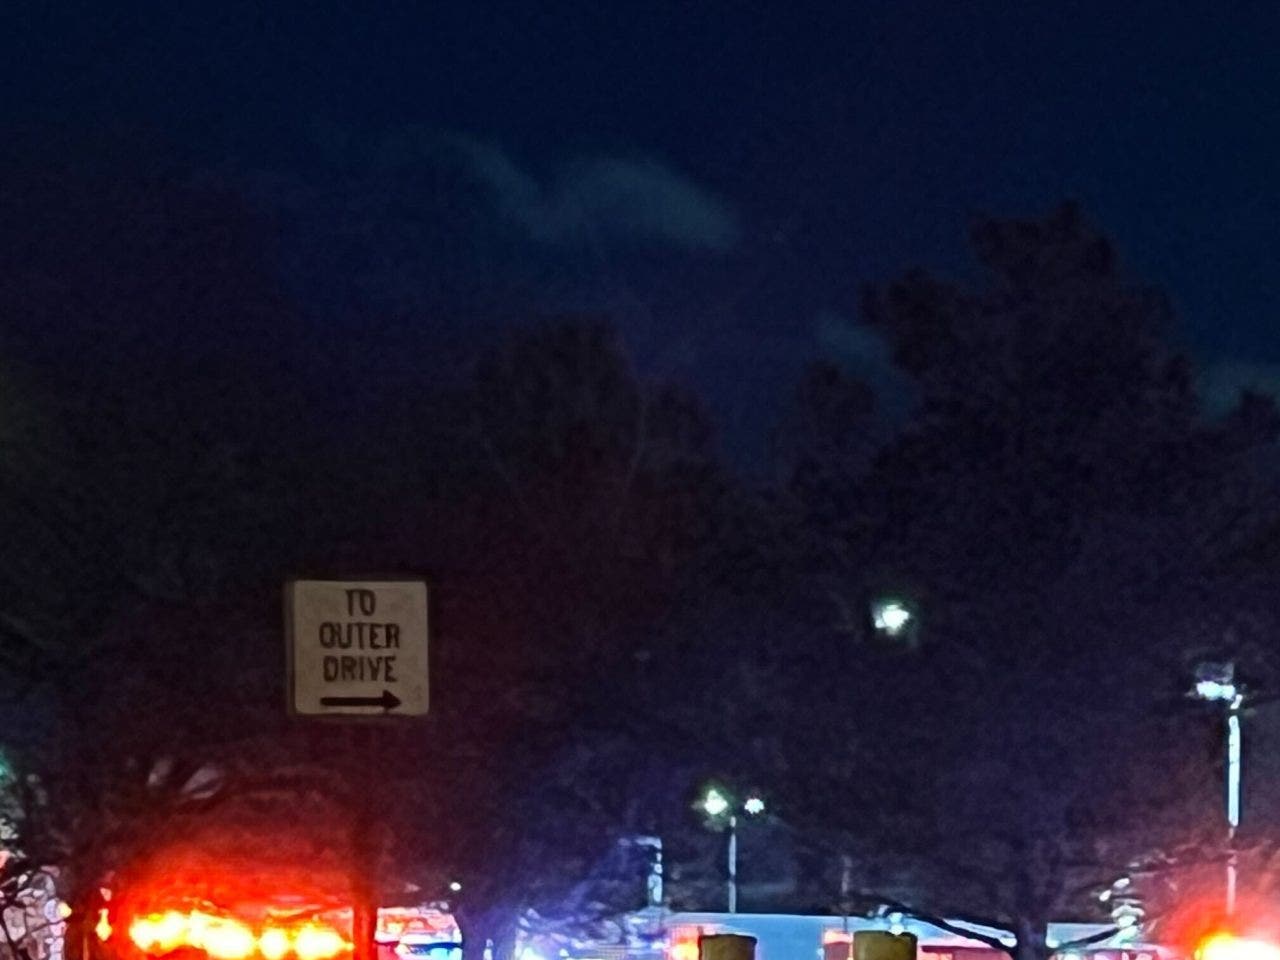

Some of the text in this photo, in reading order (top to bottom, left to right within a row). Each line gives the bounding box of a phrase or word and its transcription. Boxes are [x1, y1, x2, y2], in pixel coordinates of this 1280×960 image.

[345, 588, 377, 616] TO
[318, 621, 401, 650] OUTER
[323, 655, 398, 682] DRIVE
